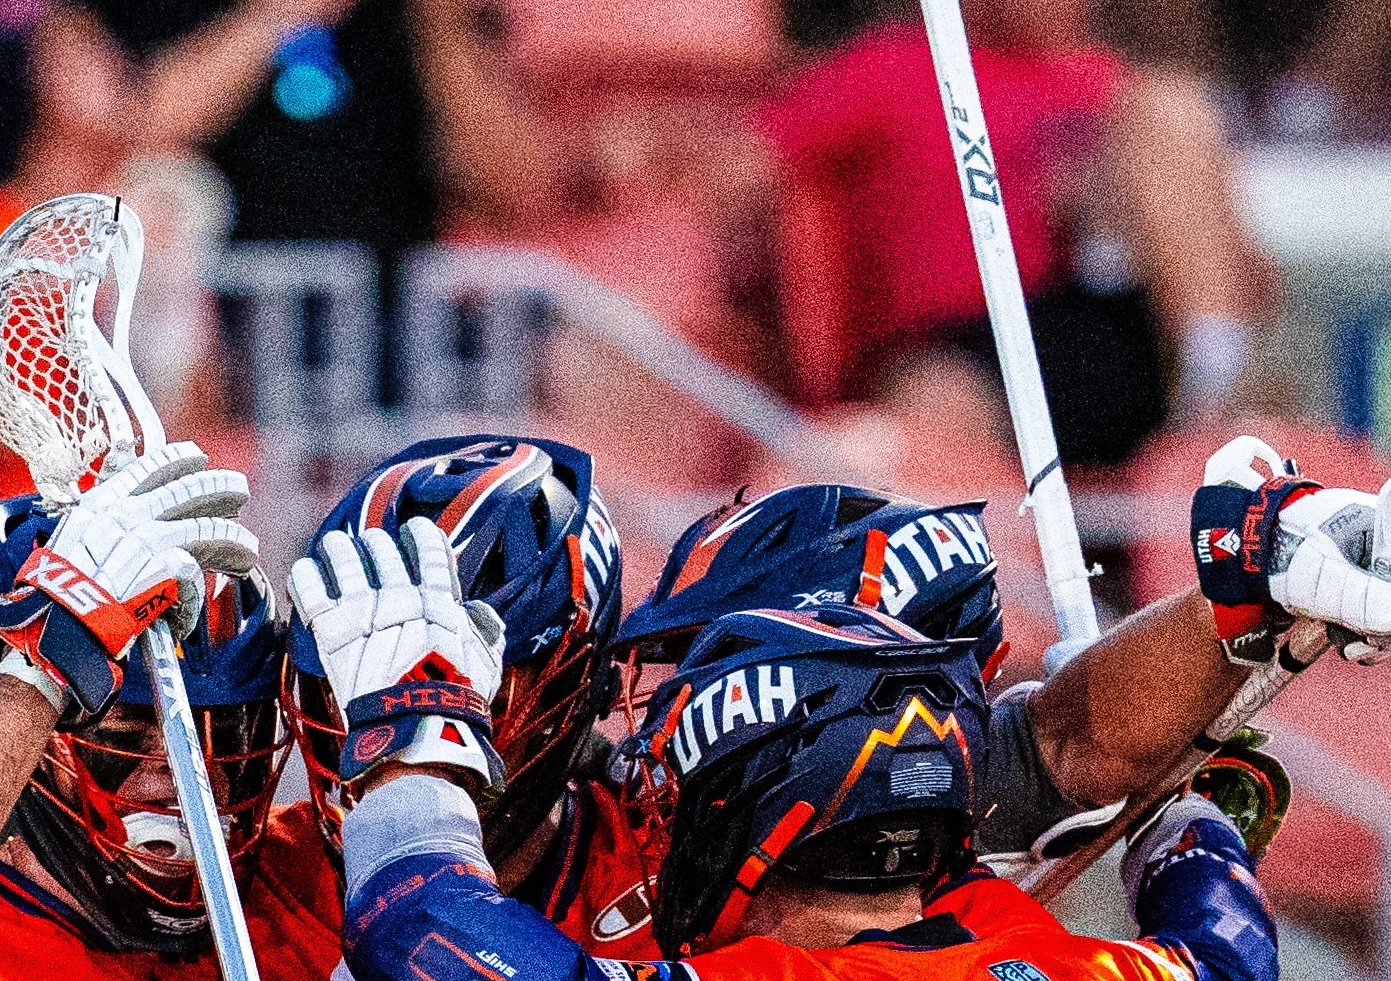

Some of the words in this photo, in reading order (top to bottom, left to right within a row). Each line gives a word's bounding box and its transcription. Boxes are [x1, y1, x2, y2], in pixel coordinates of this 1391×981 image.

[1196, 528, 1214, 564] UTAH
[25, 554, 115, 617] STX
[133, 588, 169, 622] STX
[672, 664, 798, 767] UTAH
[475, 949, 518, 978] SHIFT
